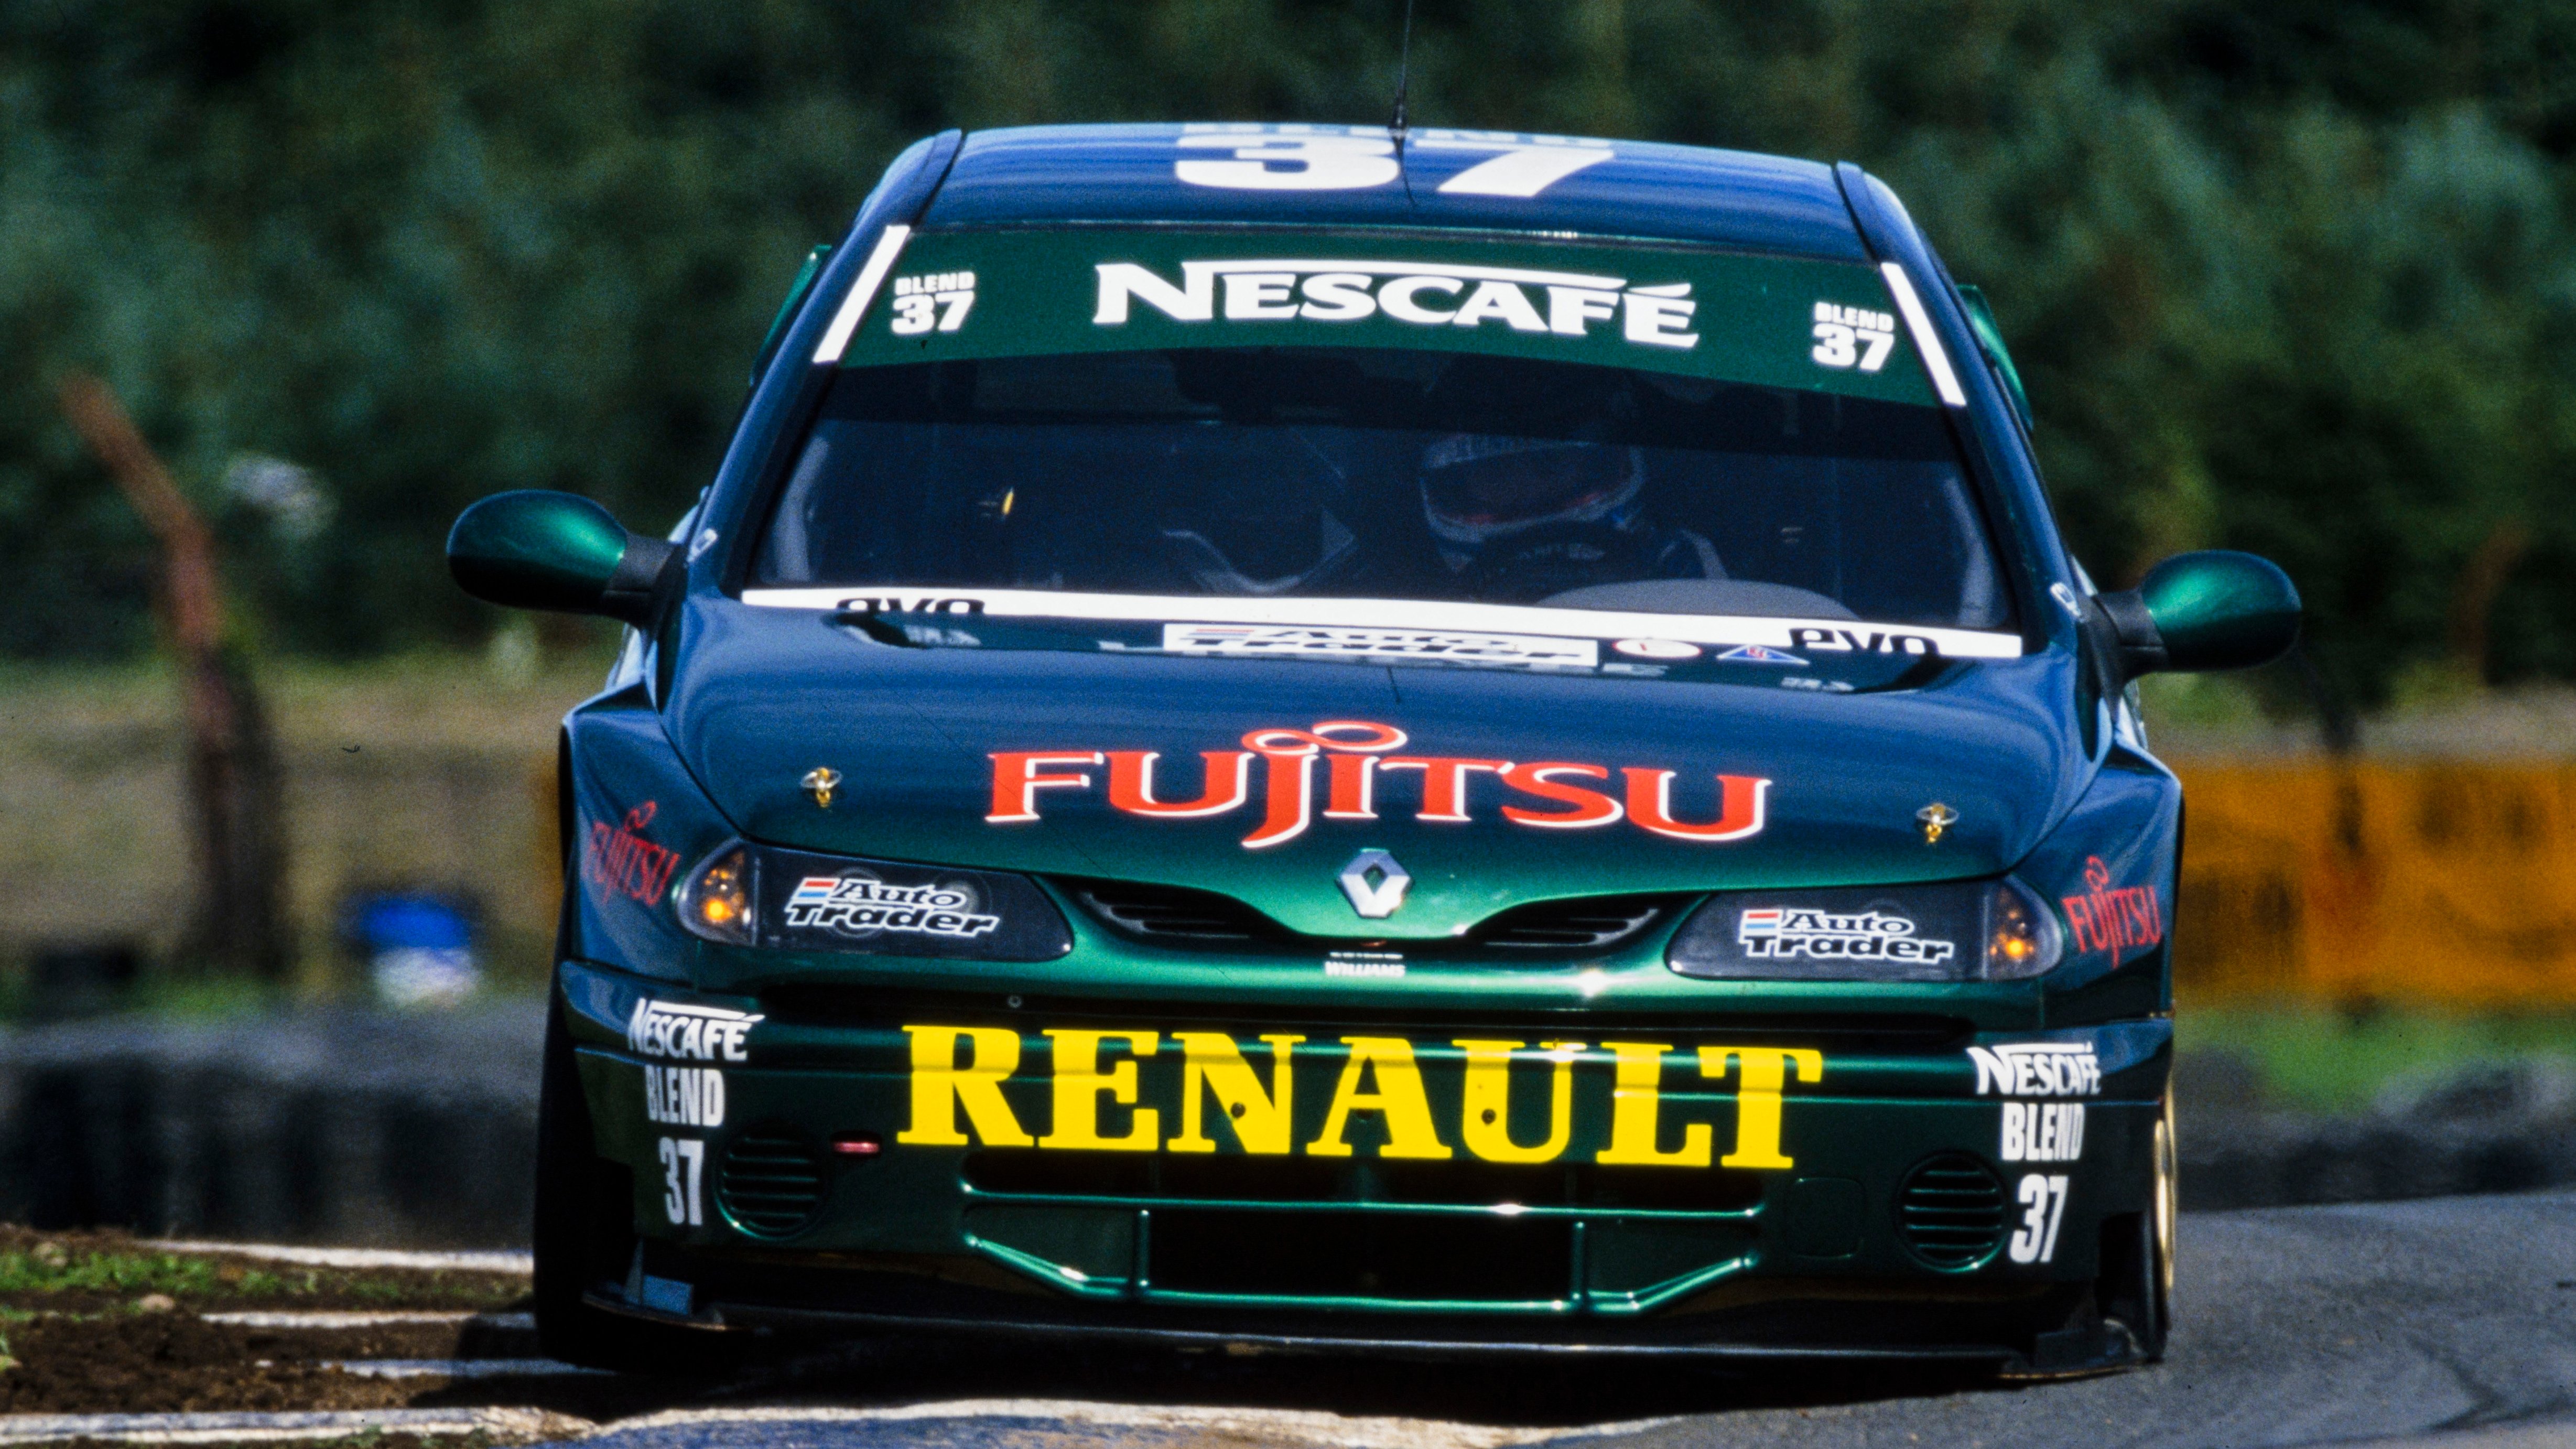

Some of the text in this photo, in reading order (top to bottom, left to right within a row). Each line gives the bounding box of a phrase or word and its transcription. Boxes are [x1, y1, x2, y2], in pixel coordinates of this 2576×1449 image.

[1175, 134, 1615, 197] 37
[891, 290, 976, 336] 37
[894, 272, 976, 296] BLEND
[1092, 259, 1700, 349] NESCAFÉ
[1812, 322, 1895, 371] 37
[1815, 301, 1895, 332] BLEND
[985, 720, 1772, 849] FUJITSU
[581, 800, 681, 907] FUJITSU
[785, 903, 1000, 937] Trader
[830, 878, 967, 909] Auto
[1781, 910, 1915, 936] Auto
[2060, 855, 2162, 969] FUJITSU
[1739, 932, 1955, 964] Trader
[629, 998, 766, 1062] NESCAFÉ
[645, 1064, 725, 1127] BLEND
[895, 1024, 1823, 1169] RENAULT
[1966, 1041, 2102, 1096] NESCAFÉ
[2001, 1102, 2086, 1161] BLEND
[658, 1136, 705, 1226] 37
[2009, 1173, 2070, 1263] 37
